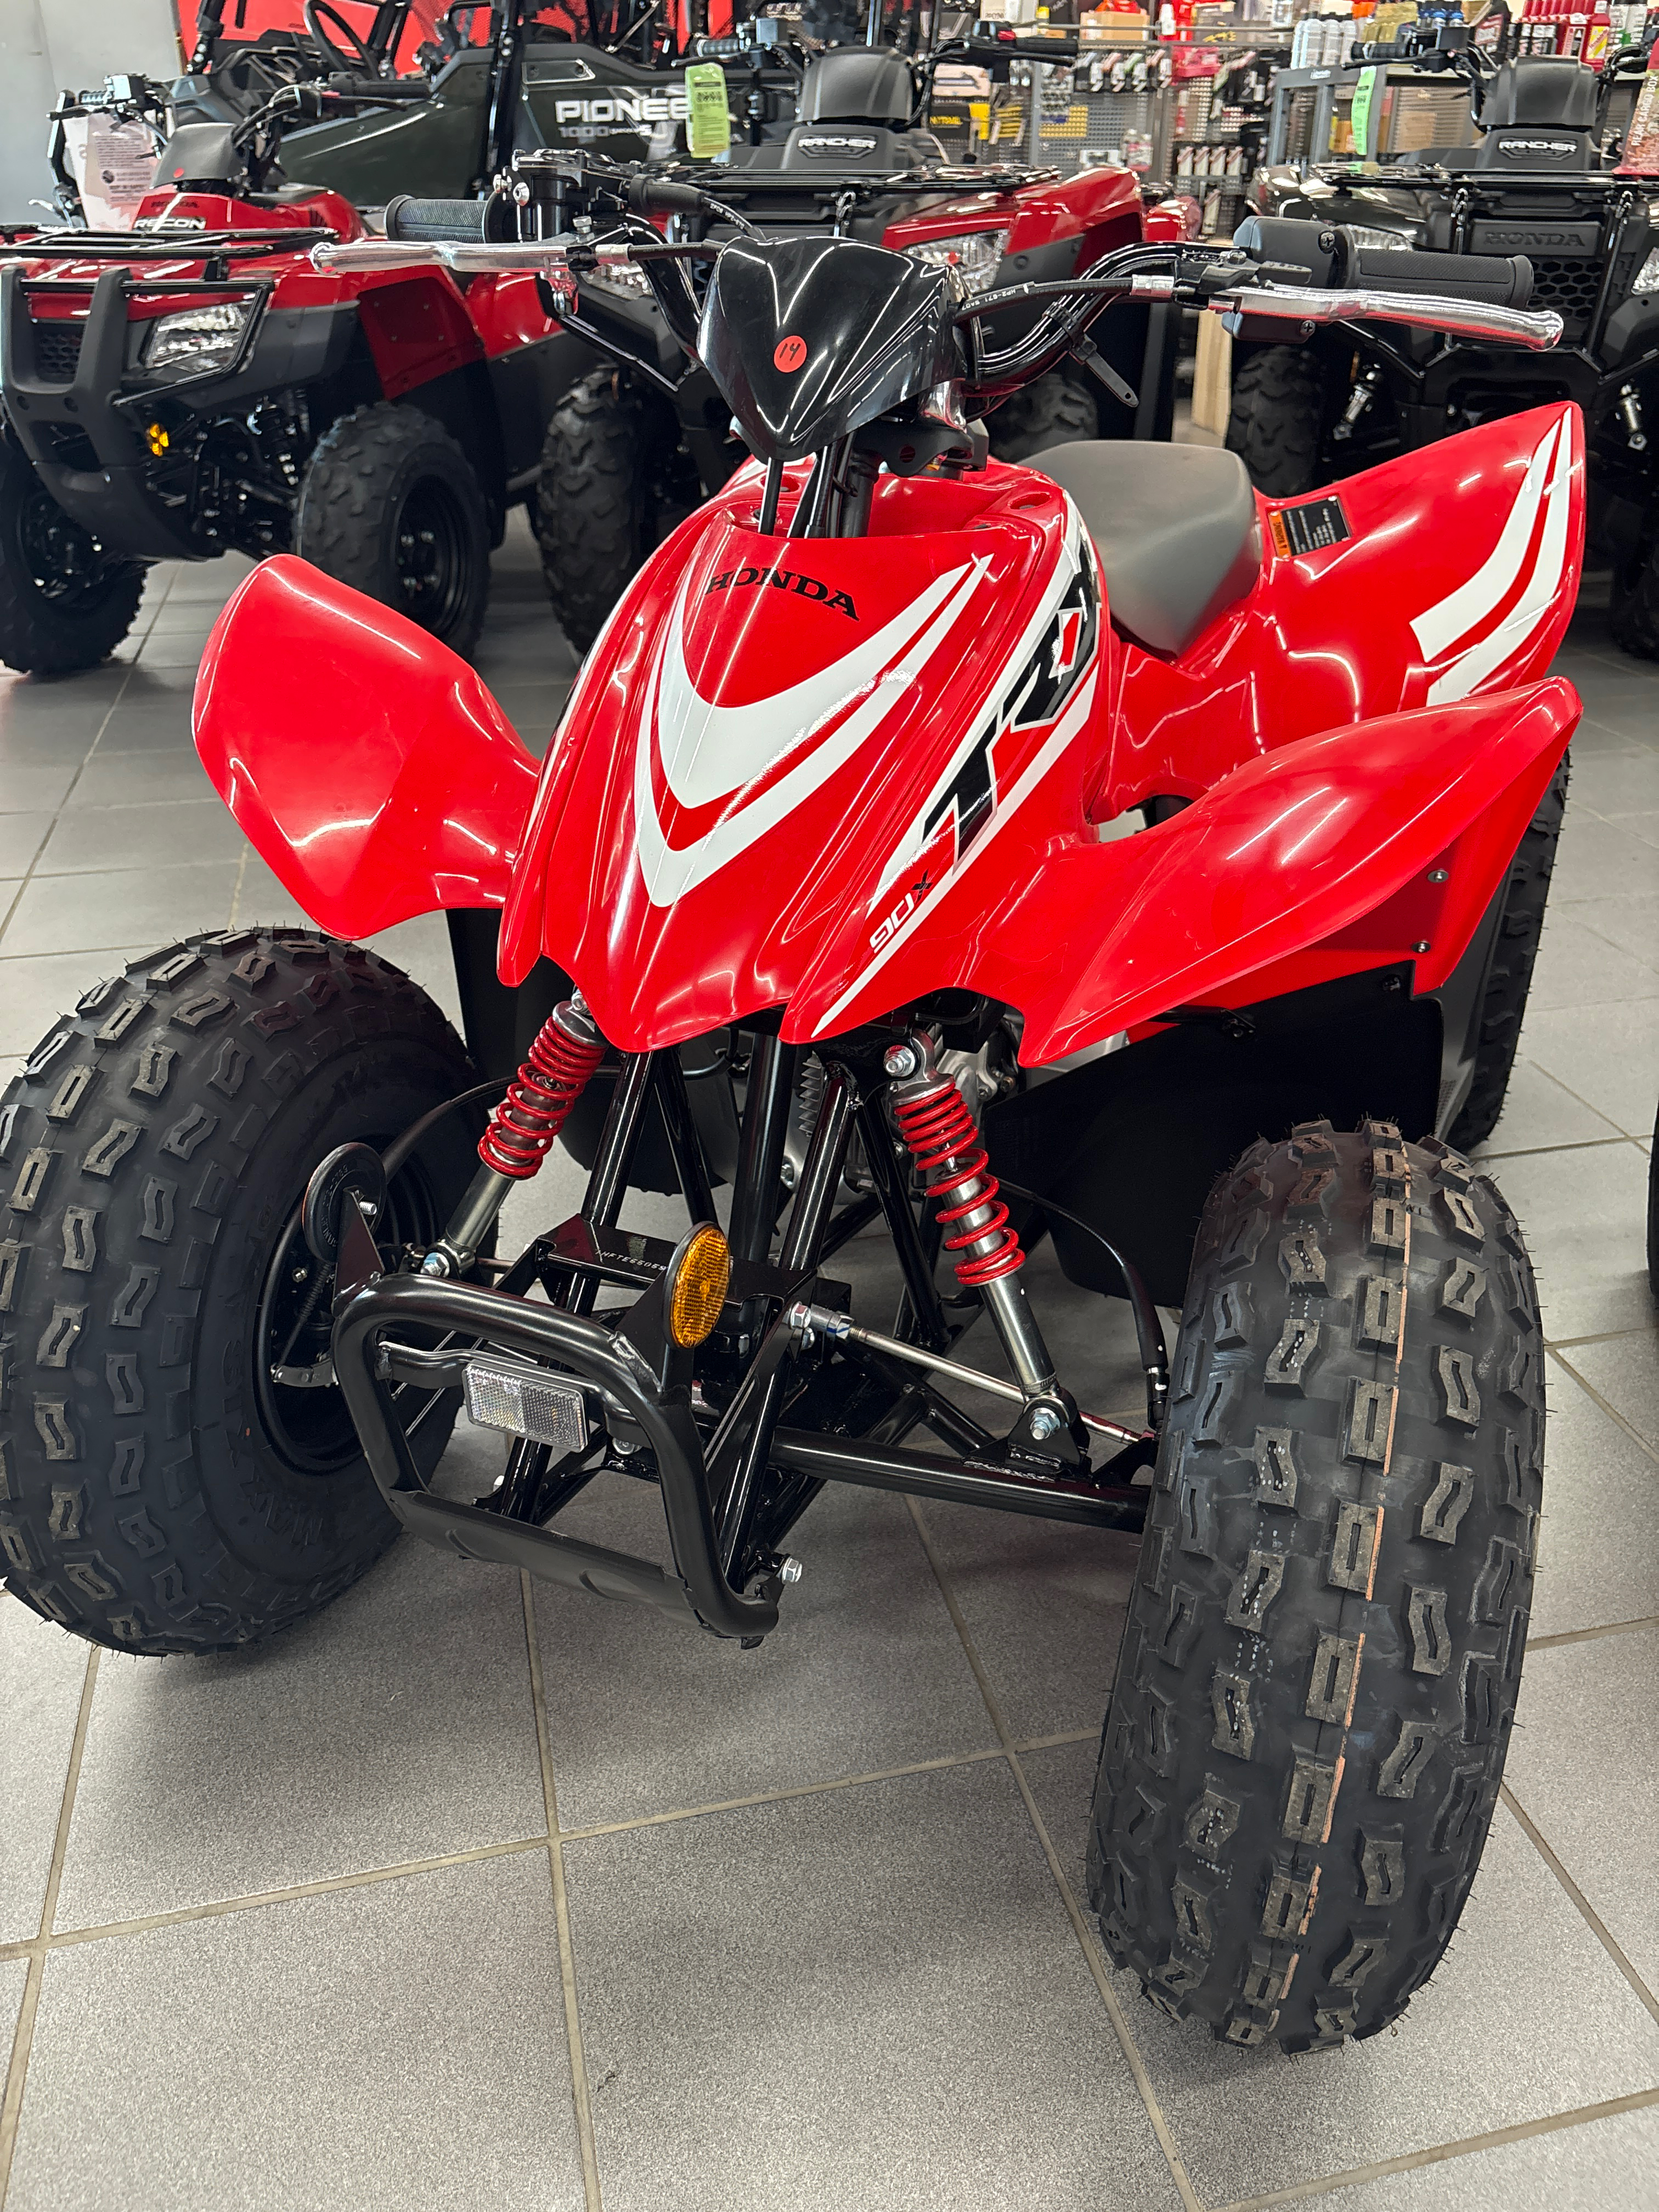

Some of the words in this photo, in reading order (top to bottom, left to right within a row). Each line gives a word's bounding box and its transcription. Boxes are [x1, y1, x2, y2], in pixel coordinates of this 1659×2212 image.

[1646, 75, 1659, 93] BOX
[555, 98, 689, 123] PIONEE
[798, 138, 877, 149] RANCHER
[1498, 141, 1577, 153] RANCHER
[1484, 232, 1585, 247] HONDA
[779, 343, 801, 362] 14
[704, 567, 860, 622] HONDA
[869, 867, 934, 954] 90X
